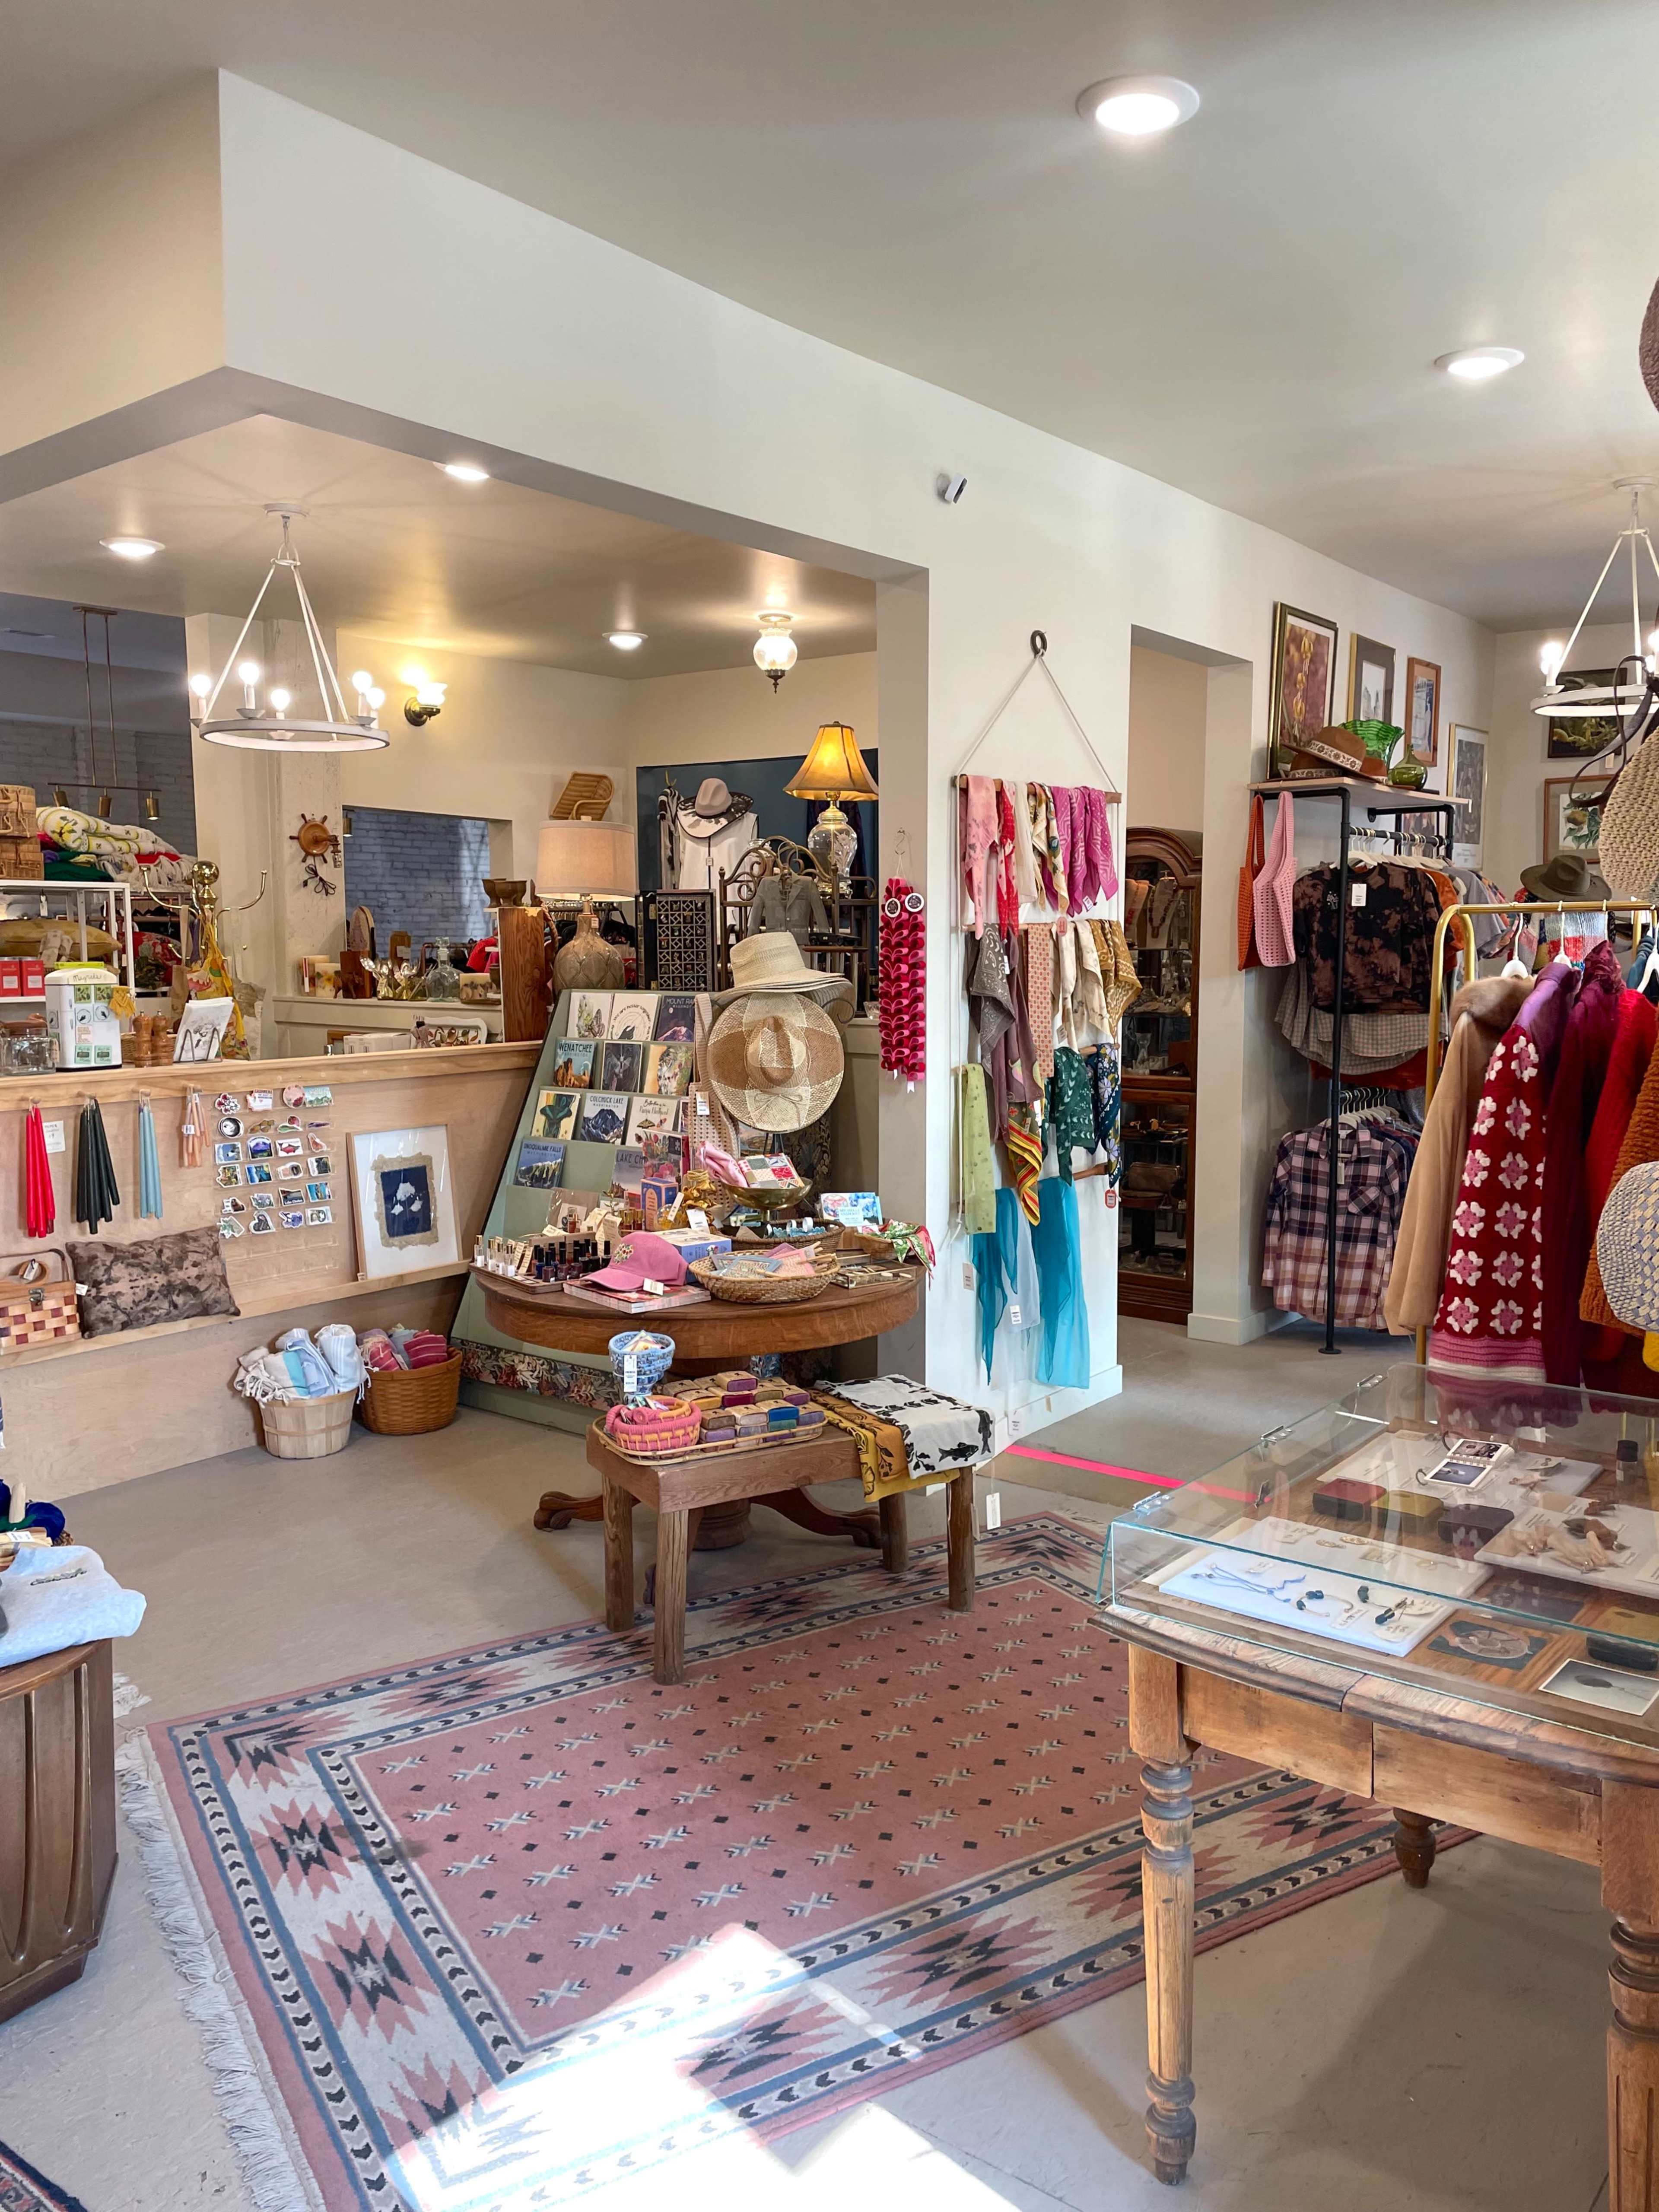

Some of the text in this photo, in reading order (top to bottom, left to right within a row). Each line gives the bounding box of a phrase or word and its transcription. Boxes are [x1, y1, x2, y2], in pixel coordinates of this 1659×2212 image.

[559, 1042, 592, 1052] WENATCHEE
[617, 1153, 643, 1164] LAKE CH
